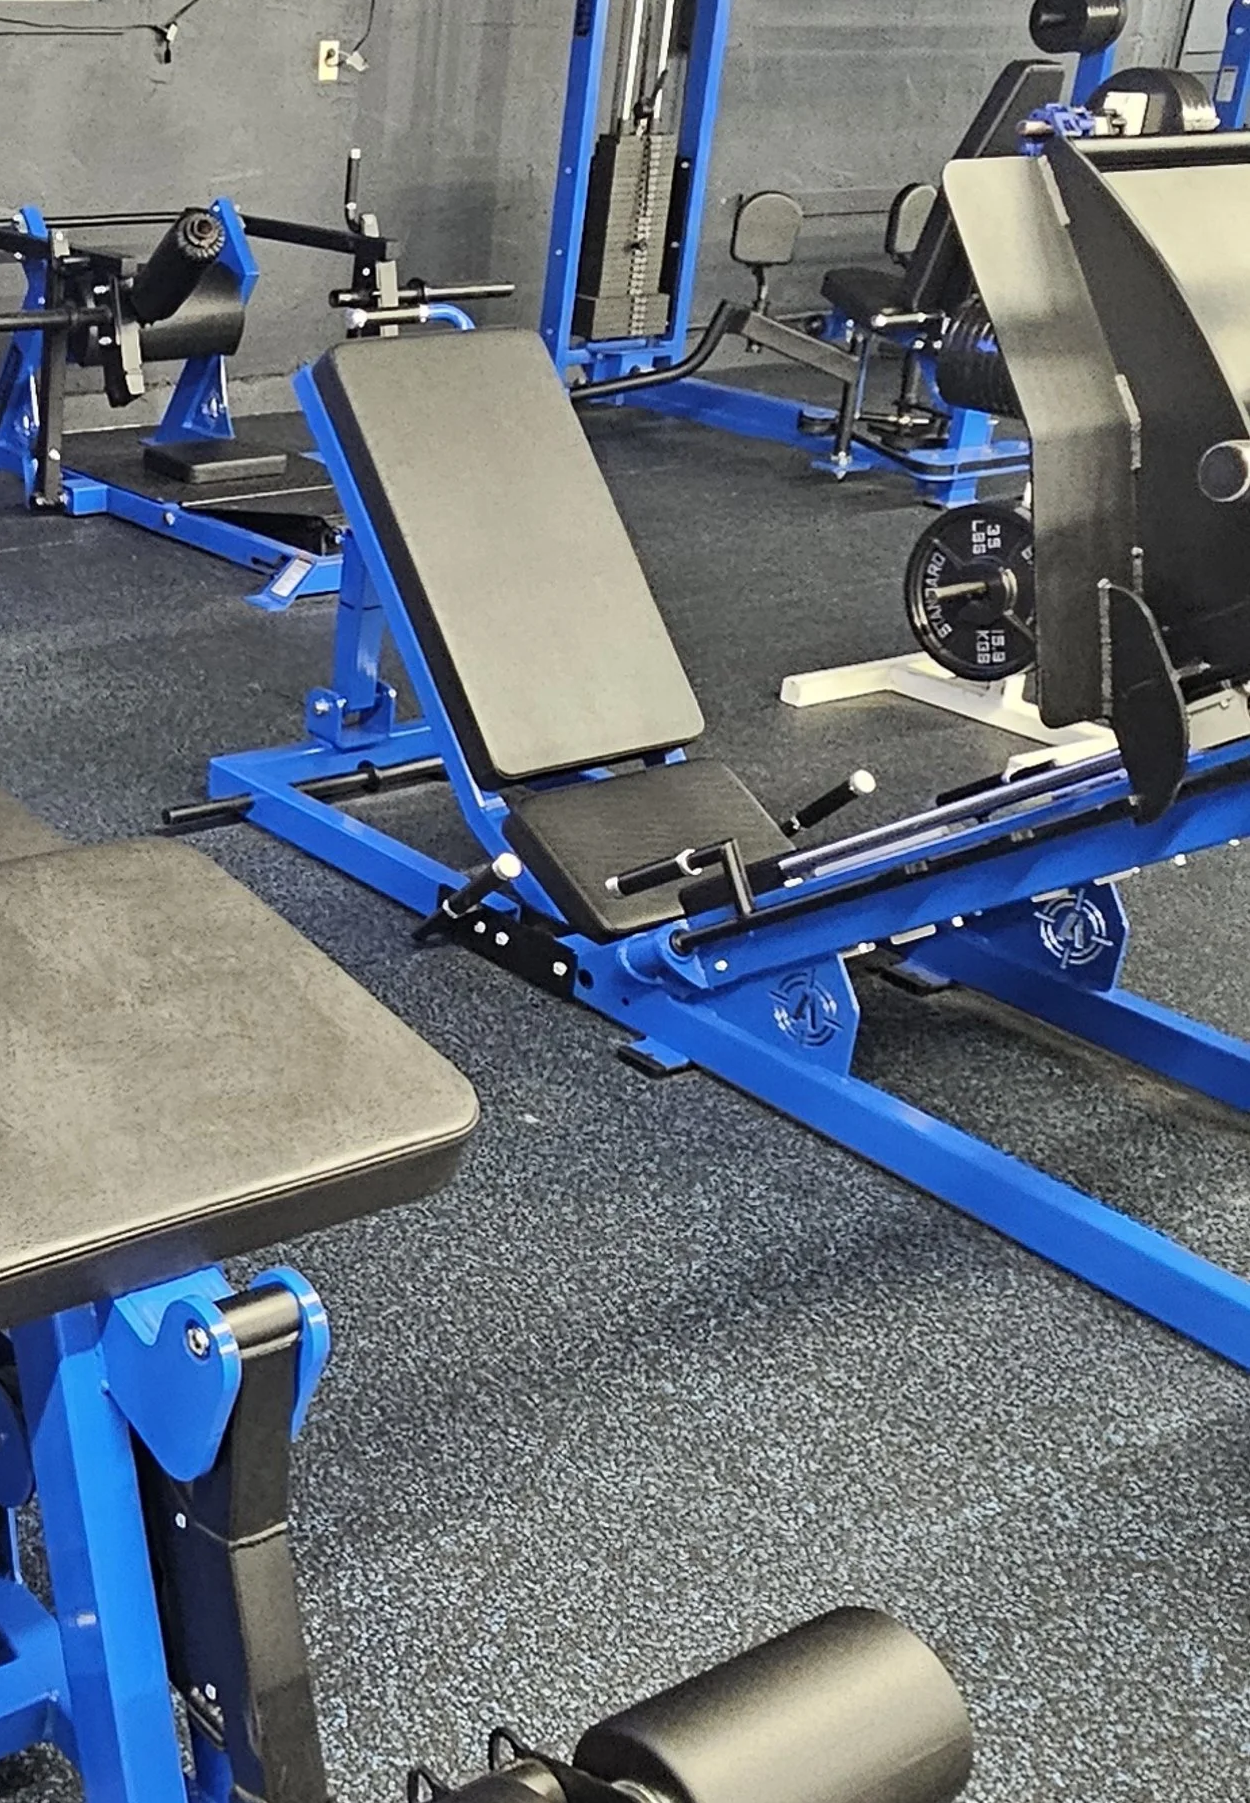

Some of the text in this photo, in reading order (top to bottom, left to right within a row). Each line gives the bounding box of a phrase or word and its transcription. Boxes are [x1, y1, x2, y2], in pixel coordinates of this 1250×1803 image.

[971, 520, 986, 554] LBS
[987, 524, 1001, 549] 35
[975, 630, 990, 664] KGS
[990, 629, 1006, 663] 15.9
